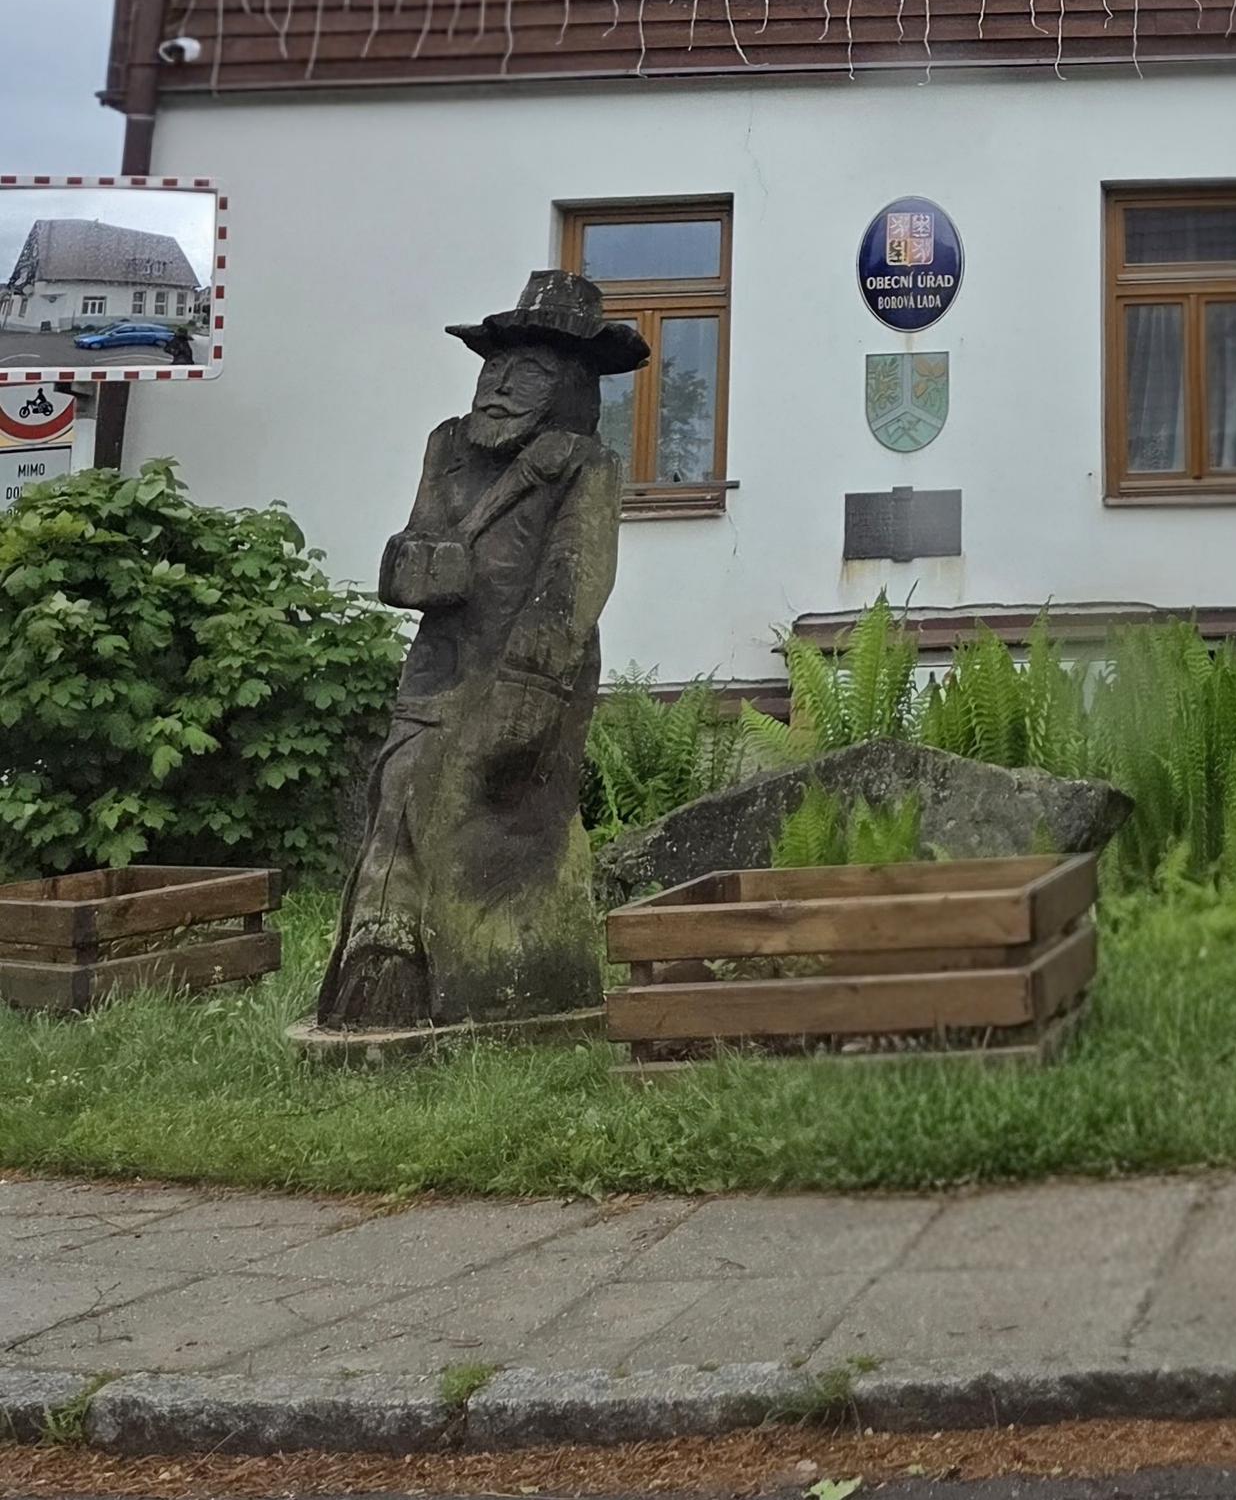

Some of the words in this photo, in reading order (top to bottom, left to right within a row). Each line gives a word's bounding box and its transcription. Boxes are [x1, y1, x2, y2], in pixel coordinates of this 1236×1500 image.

[866, 271, 913, 290] OBECNÍ
[917, 271, 954, 288] ÚŘAD
[878, 292, 915, 310] BOROVÁ
[917, 294, 942, 308] LADA
[18, 463, 45, 477] MIMO
